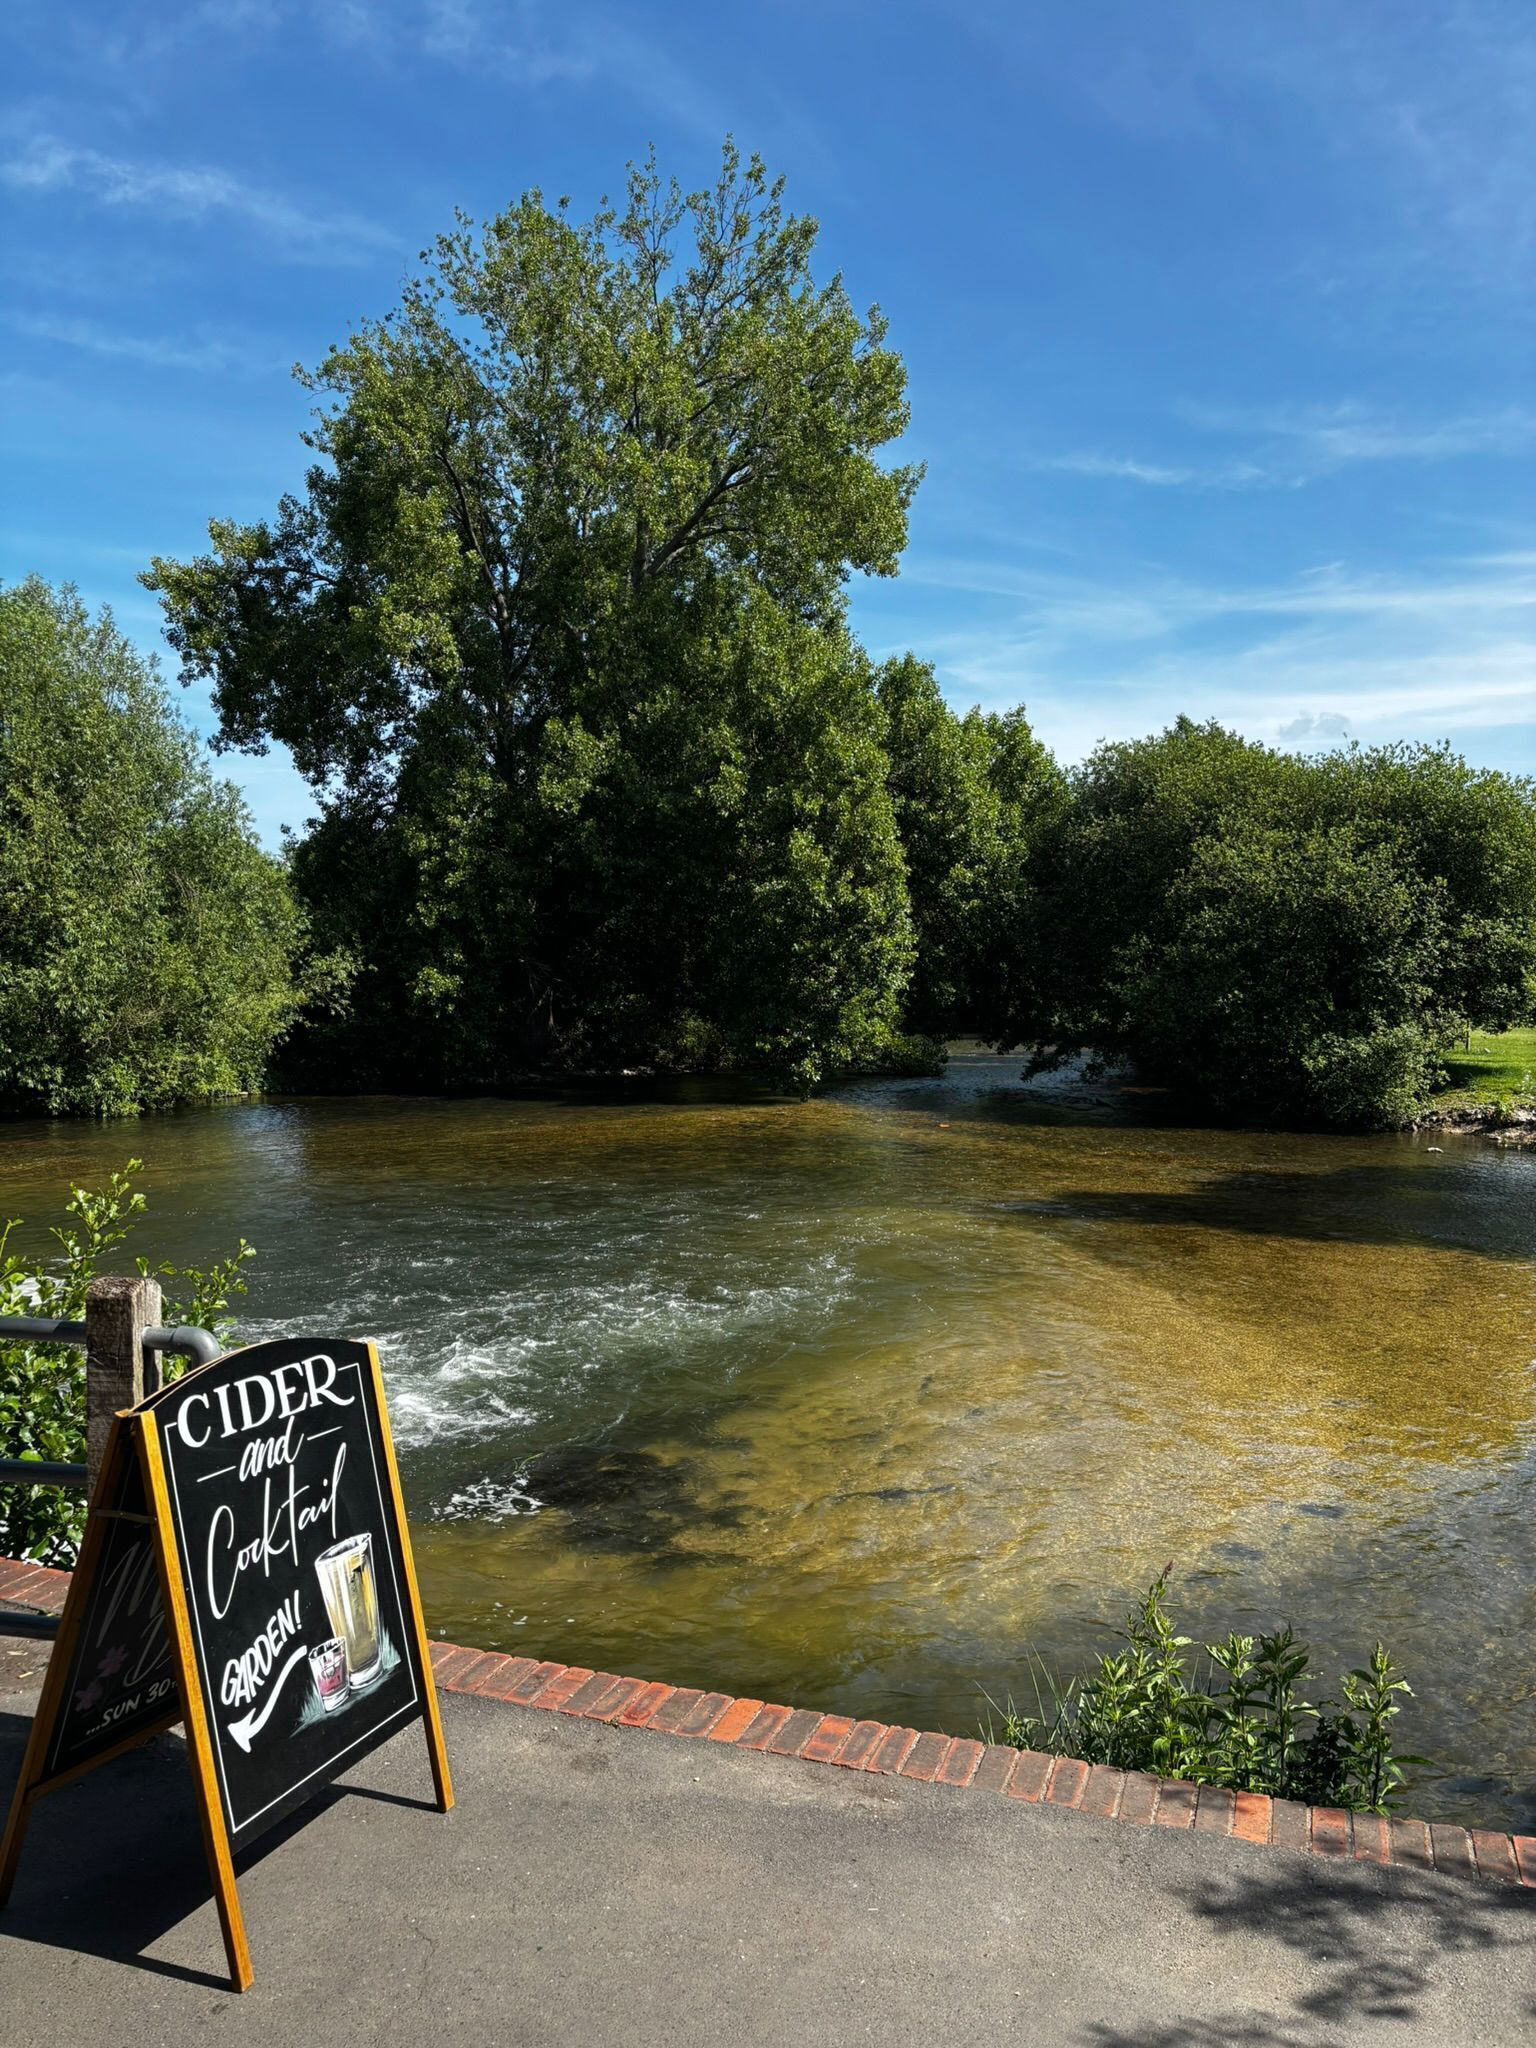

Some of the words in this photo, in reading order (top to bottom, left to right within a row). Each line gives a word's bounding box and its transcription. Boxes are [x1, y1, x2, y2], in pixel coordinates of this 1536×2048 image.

[177, 1354, 355, 1448] CIDER
[238, 1416, 304, 1482] and
[207, 1441, 347, 1619] Cocktail
[221, 1590, 302, 1708] GARDEN!
